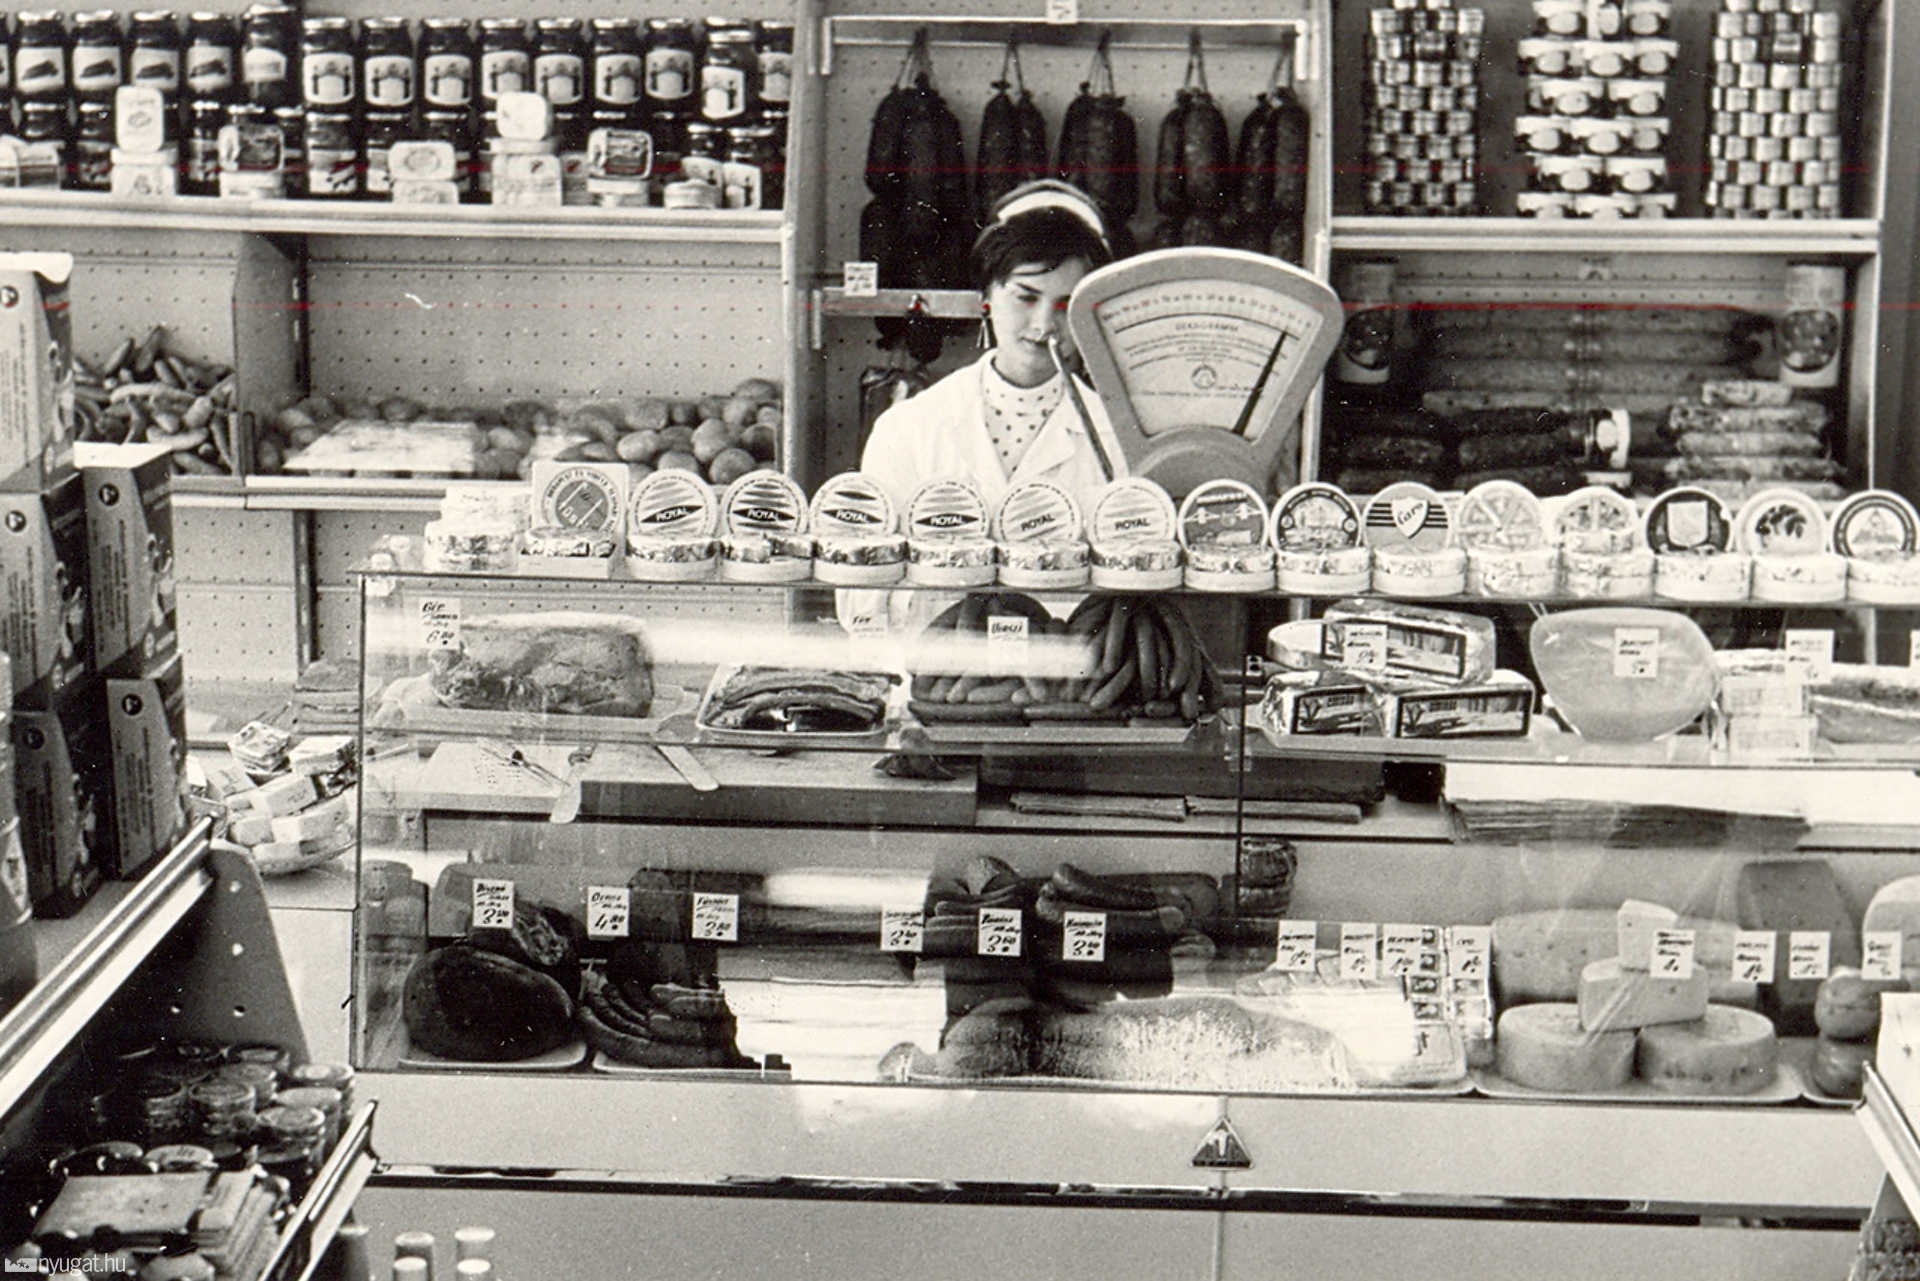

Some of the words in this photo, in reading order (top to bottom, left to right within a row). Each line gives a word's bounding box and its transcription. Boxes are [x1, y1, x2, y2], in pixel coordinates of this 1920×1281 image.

[656, 508, 688, 522] ROYAL
[747, 509, 779, 521] ROYAL
[836, 510, 868, 523] ROYAL
[931, 516, 963, 526] ROYAL
[1020, 514, 1056, 531] ROYAL
[1115, 518, 1151, 531] ROYAL
